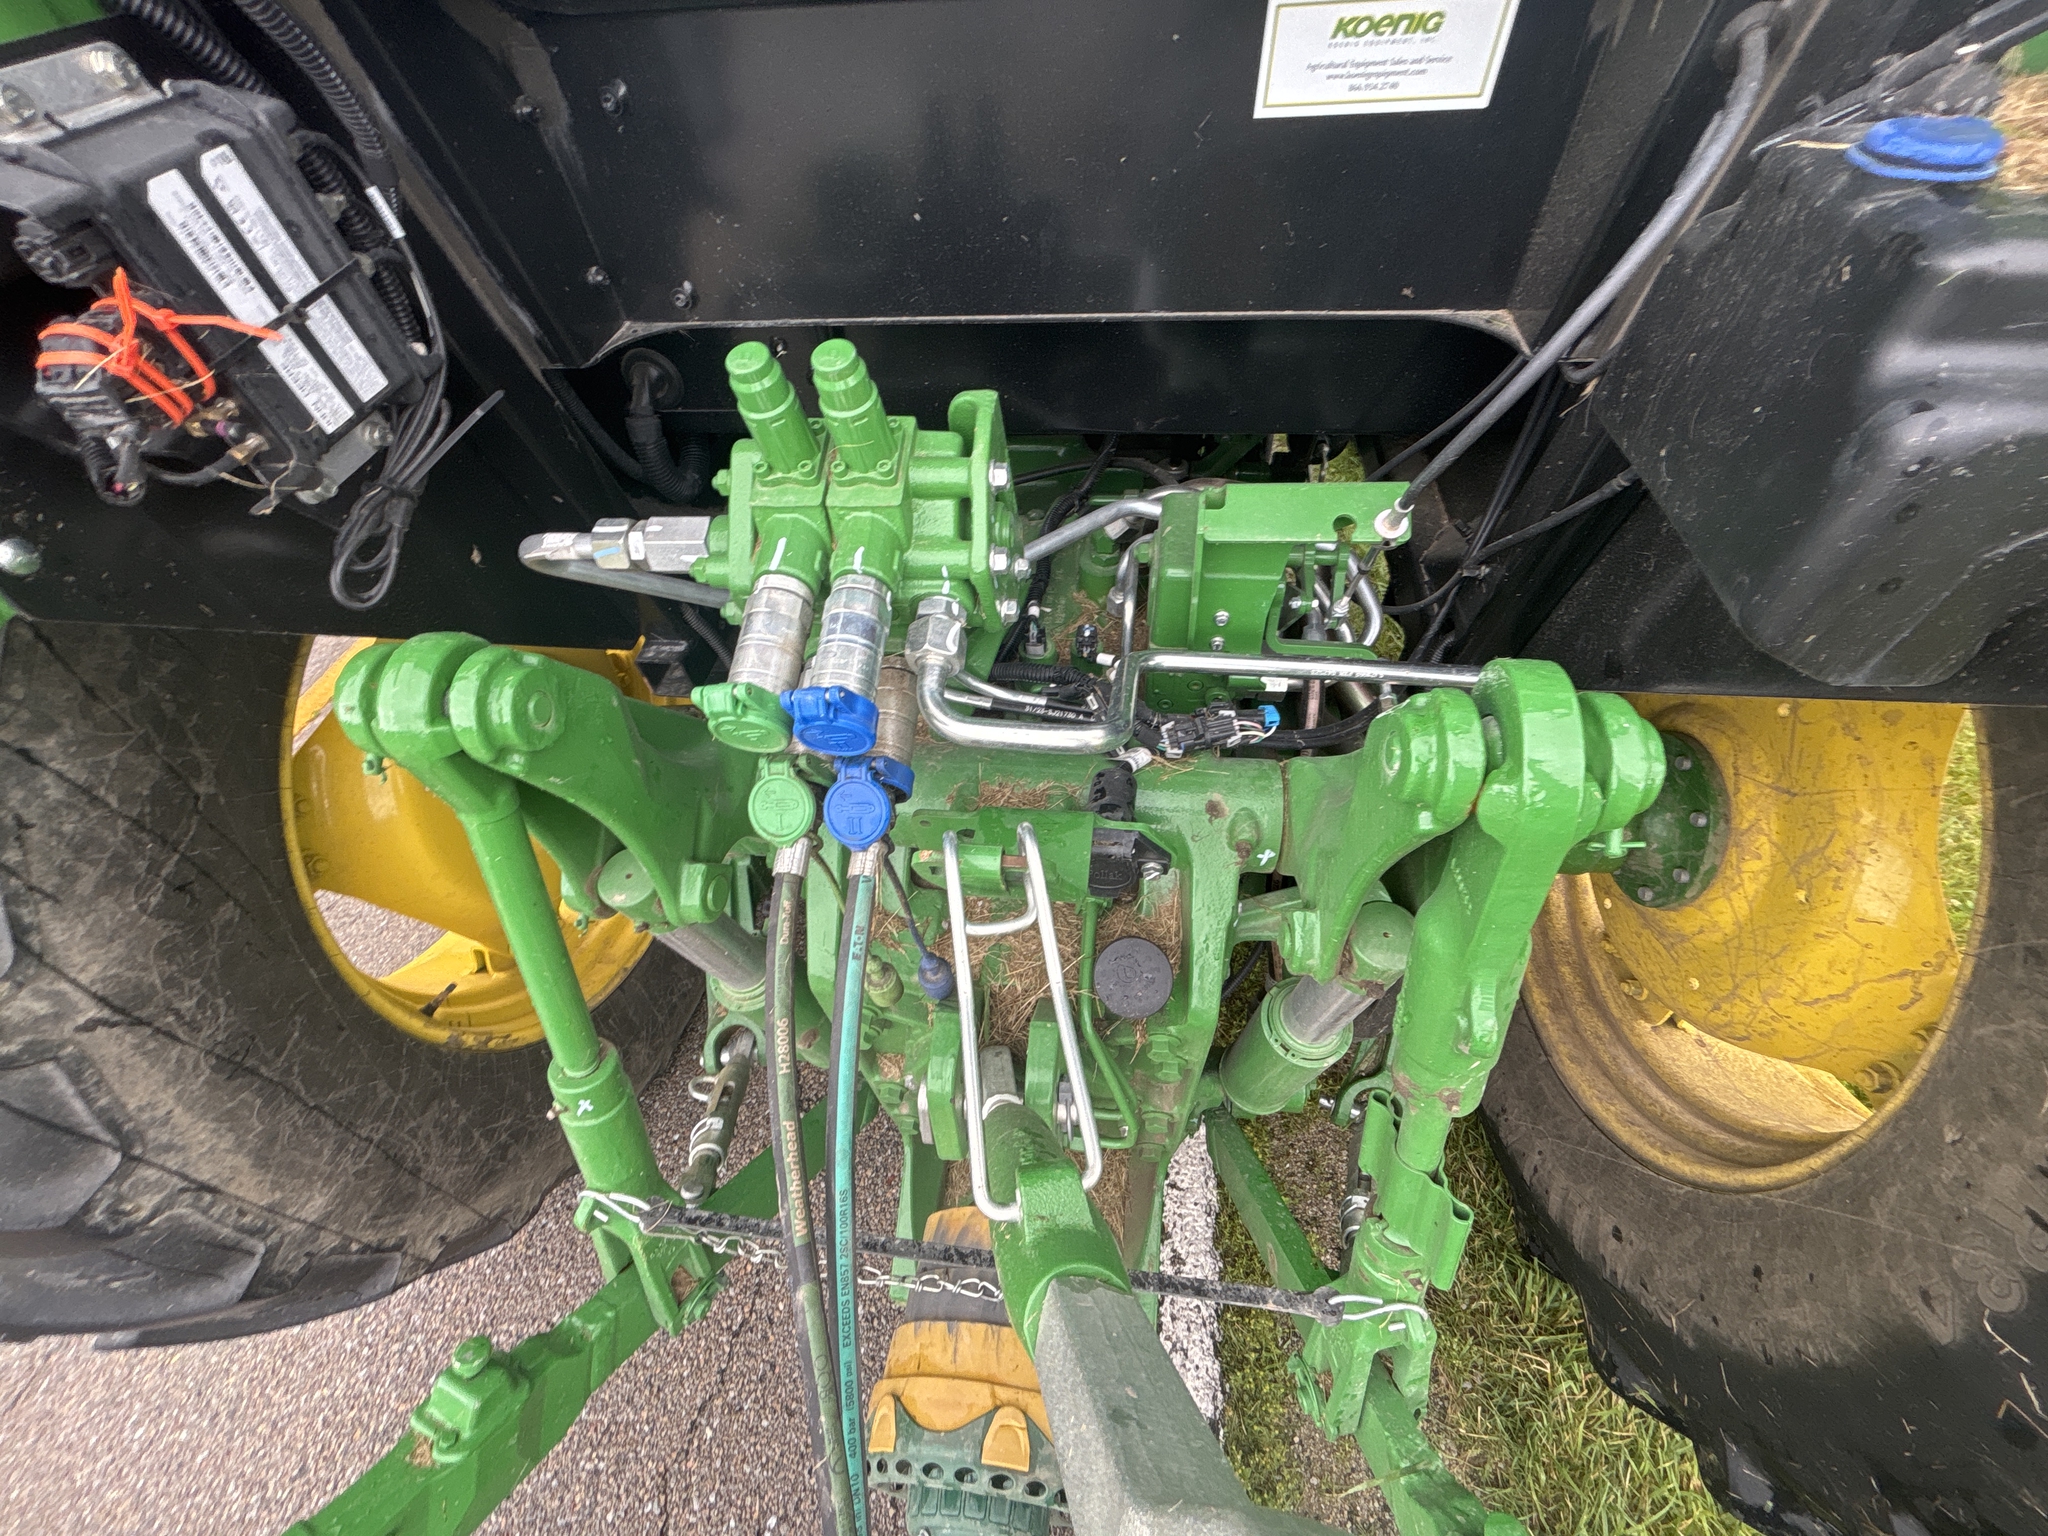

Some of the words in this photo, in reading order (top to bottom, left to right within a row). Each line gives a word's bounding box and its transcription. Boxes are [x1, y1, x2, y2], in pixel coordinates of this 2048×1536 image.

[776, 1017, 791, 1075] H28006
[783, 1120, 808, 1237] Weatherhead
[839, 1189, 850, 1259] 2SC/100R16S
[840, 1264, 850, 1296] EN857
[841, 1299, 852, 1348] EXCEEDS
[844, 1380, 855, 1411] (5800
[847, 1417, 856, 1435] bar
[847, 1437, 858, 1459] 400
